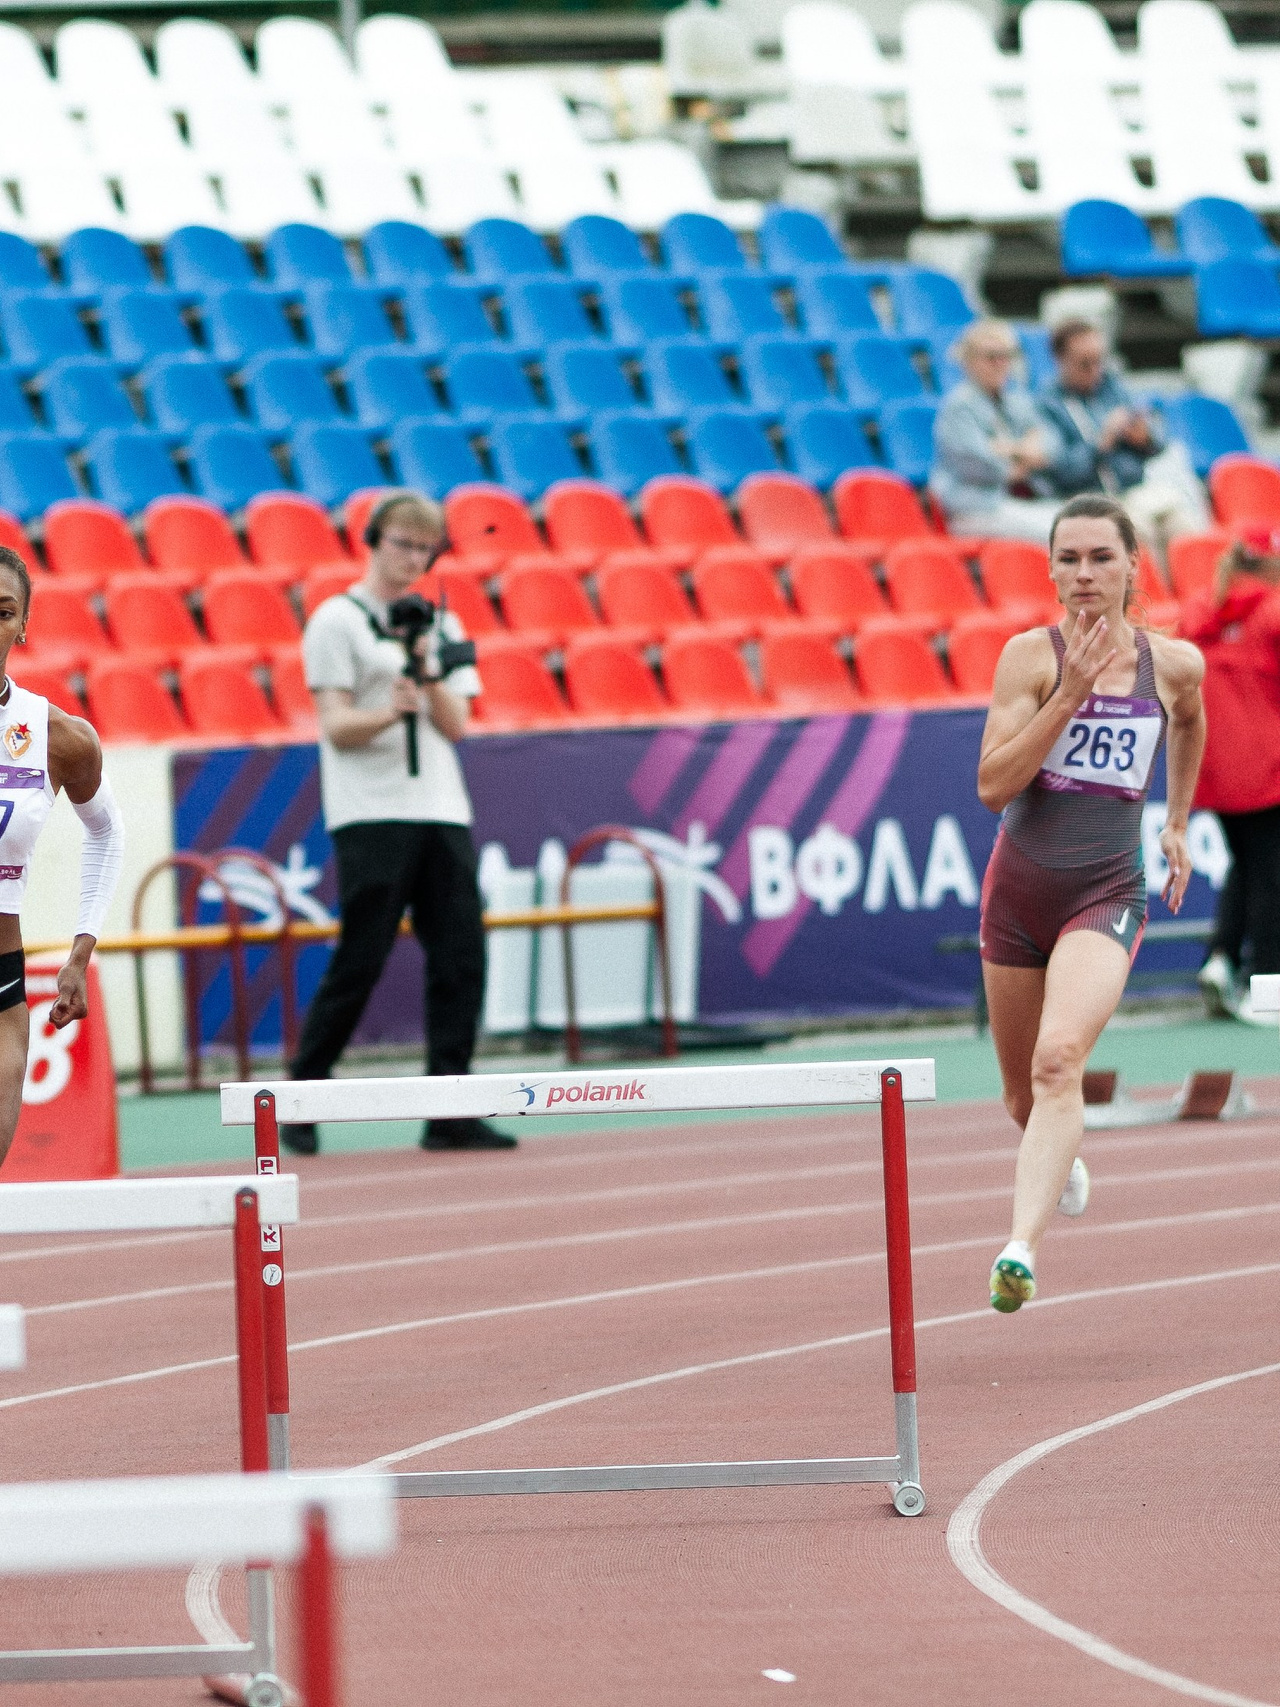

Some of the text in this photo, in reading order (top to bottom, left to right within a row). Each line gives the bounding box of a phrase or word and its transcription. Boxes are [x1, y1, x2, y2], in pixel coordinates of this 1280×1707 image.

[1063, 723, 1137, 772] 263
[747, 814, 981, 920] ВФЛА
[546, 1078, 647, 1109] polanik
